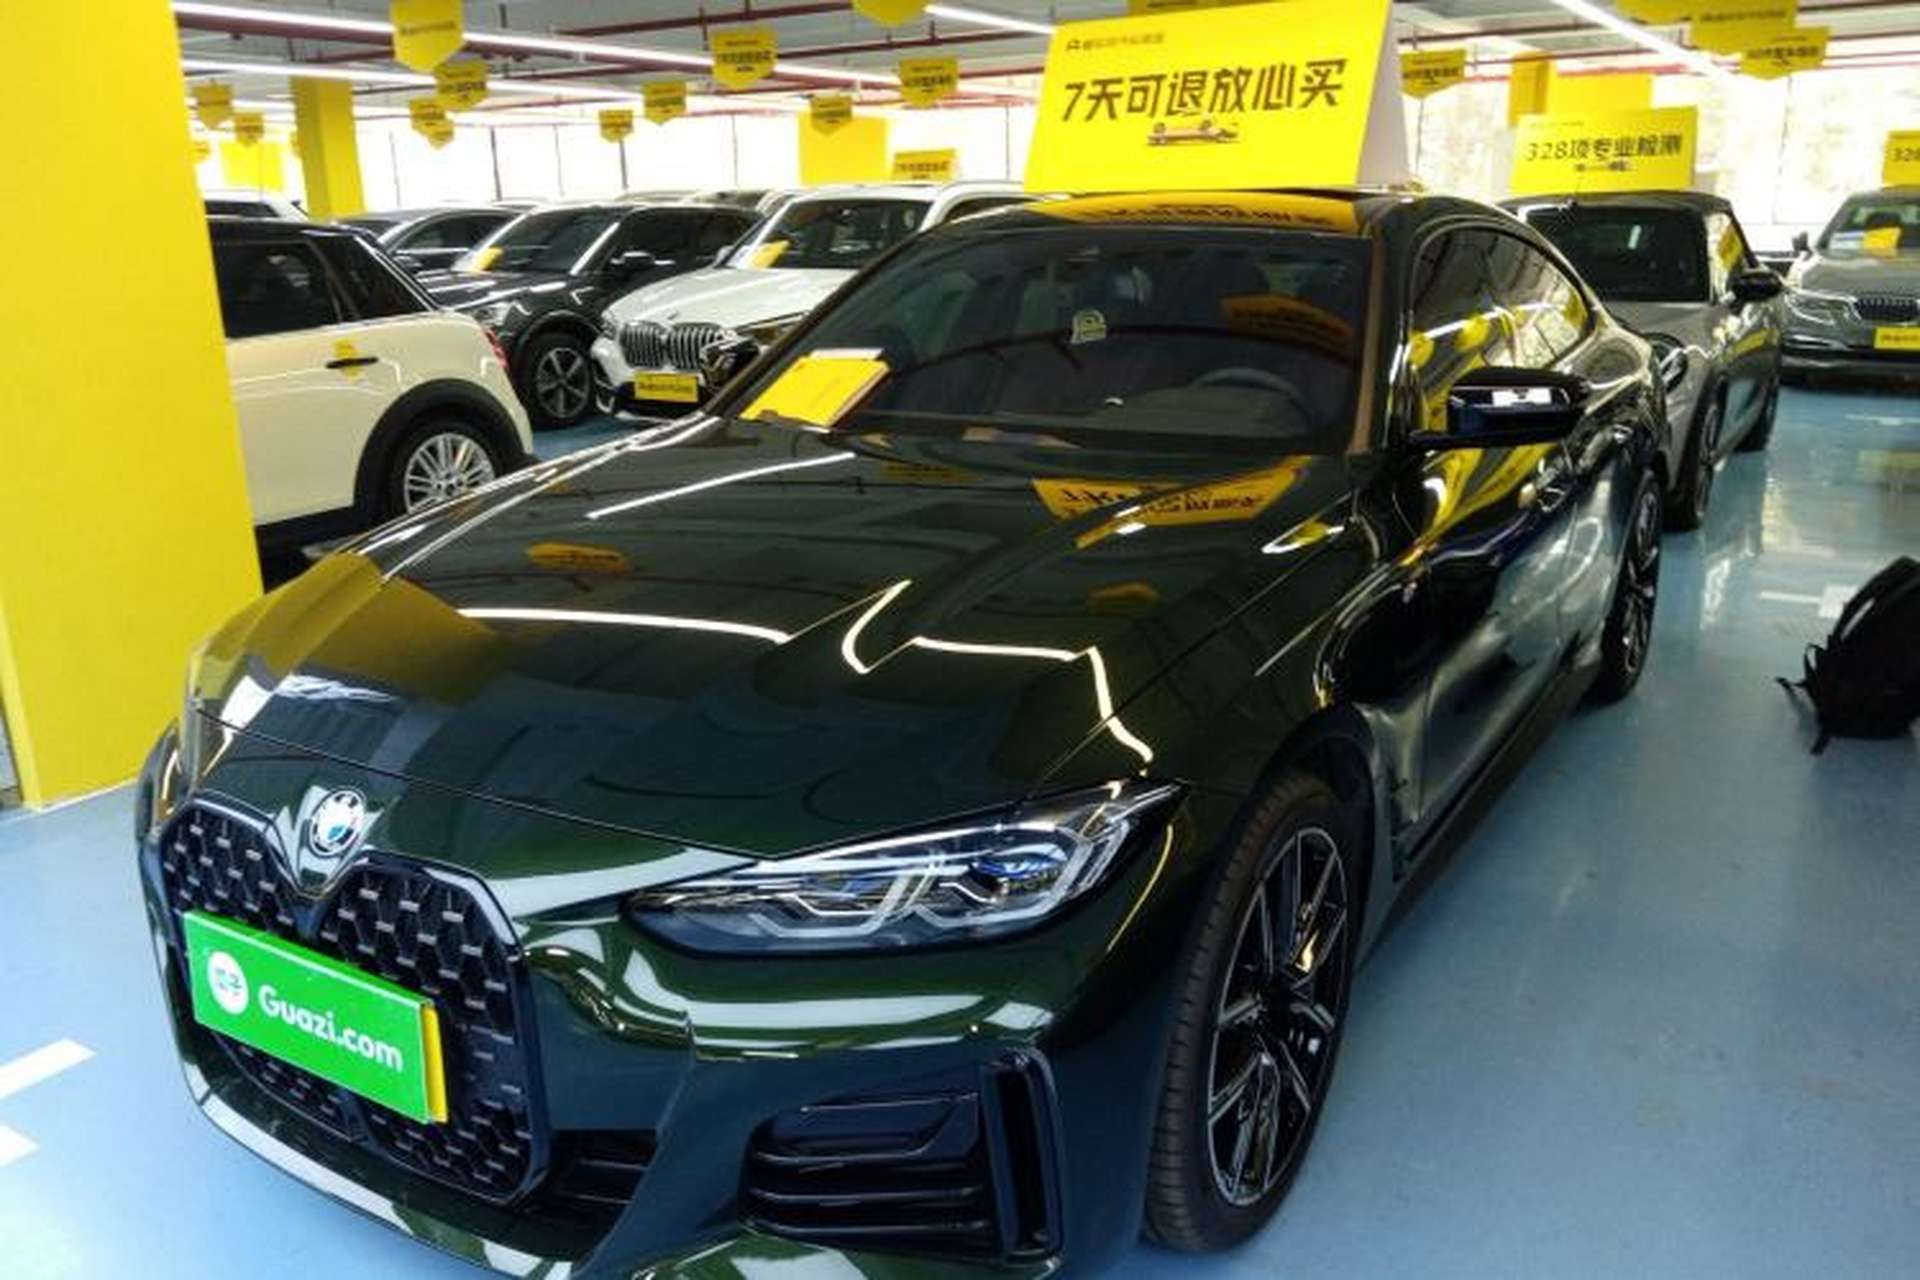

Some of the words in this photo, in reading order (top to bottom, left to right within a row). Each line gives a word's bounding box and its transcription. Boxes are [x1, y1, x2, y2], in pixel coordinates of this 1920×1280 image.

[1062, 58, 1348, 122] 7天可退放心买
[258, 985, 403, 1071] Guazi.com
